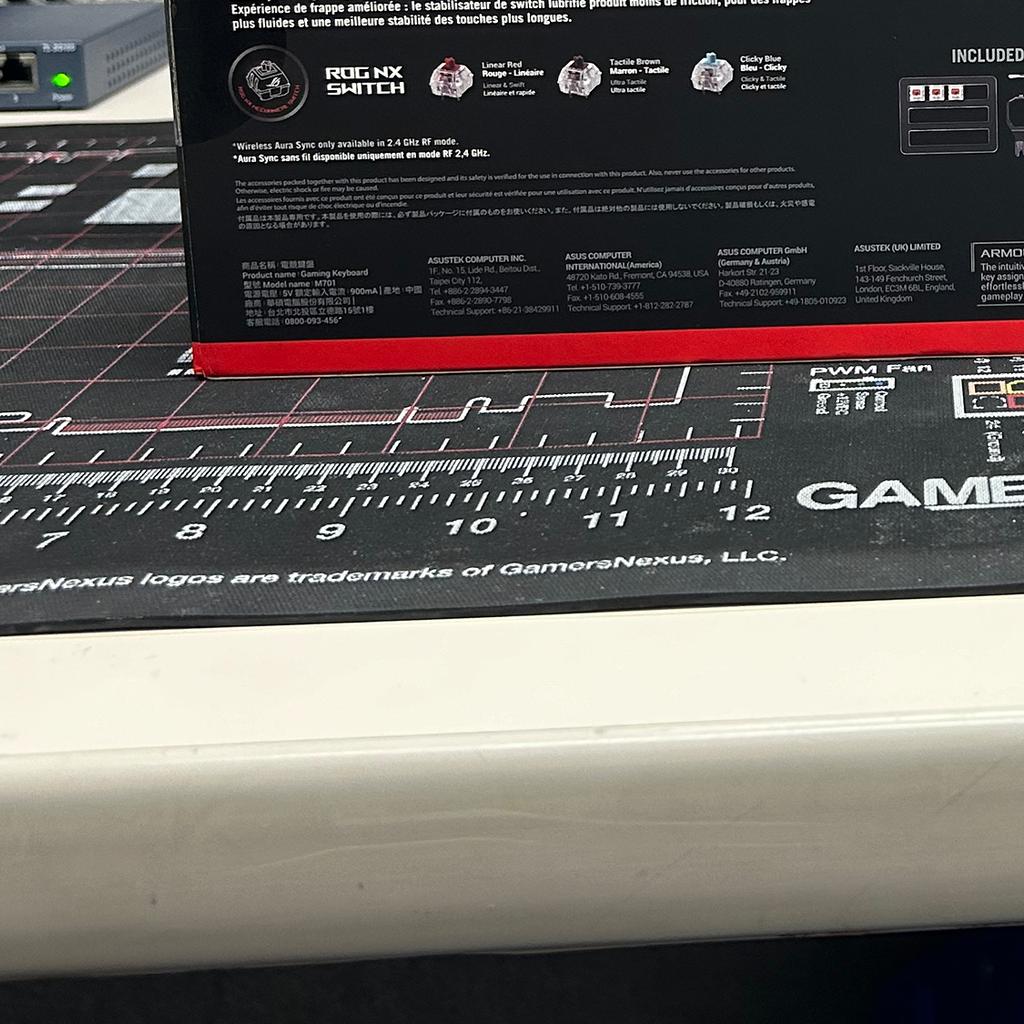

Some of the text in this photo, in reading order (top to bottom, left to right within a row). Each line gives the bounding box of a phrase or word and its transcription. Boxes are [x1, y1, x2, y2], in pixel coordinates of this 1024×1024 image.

[636, 57, 660, 65] Brown
[740, 55, 781, 64] Clicky Blue
[952, 47, 1024, 62] INCLUDED
[325, 65, 402, 79] ROG NX
[326, 81, 404, 95] SWITCH
[854, 242, 941, 252] ASUSTEK (UK) LIMITED
[809, 363, 933, 377] PWM Fan
[36, 504, 772, 549] 7 8 9 10 11 12
[139, 574, 224, 586] logos
[230, 574, 279, 584] are
[287, 567, 453, 583] trademarks
[461, 564, 494, 577] of
